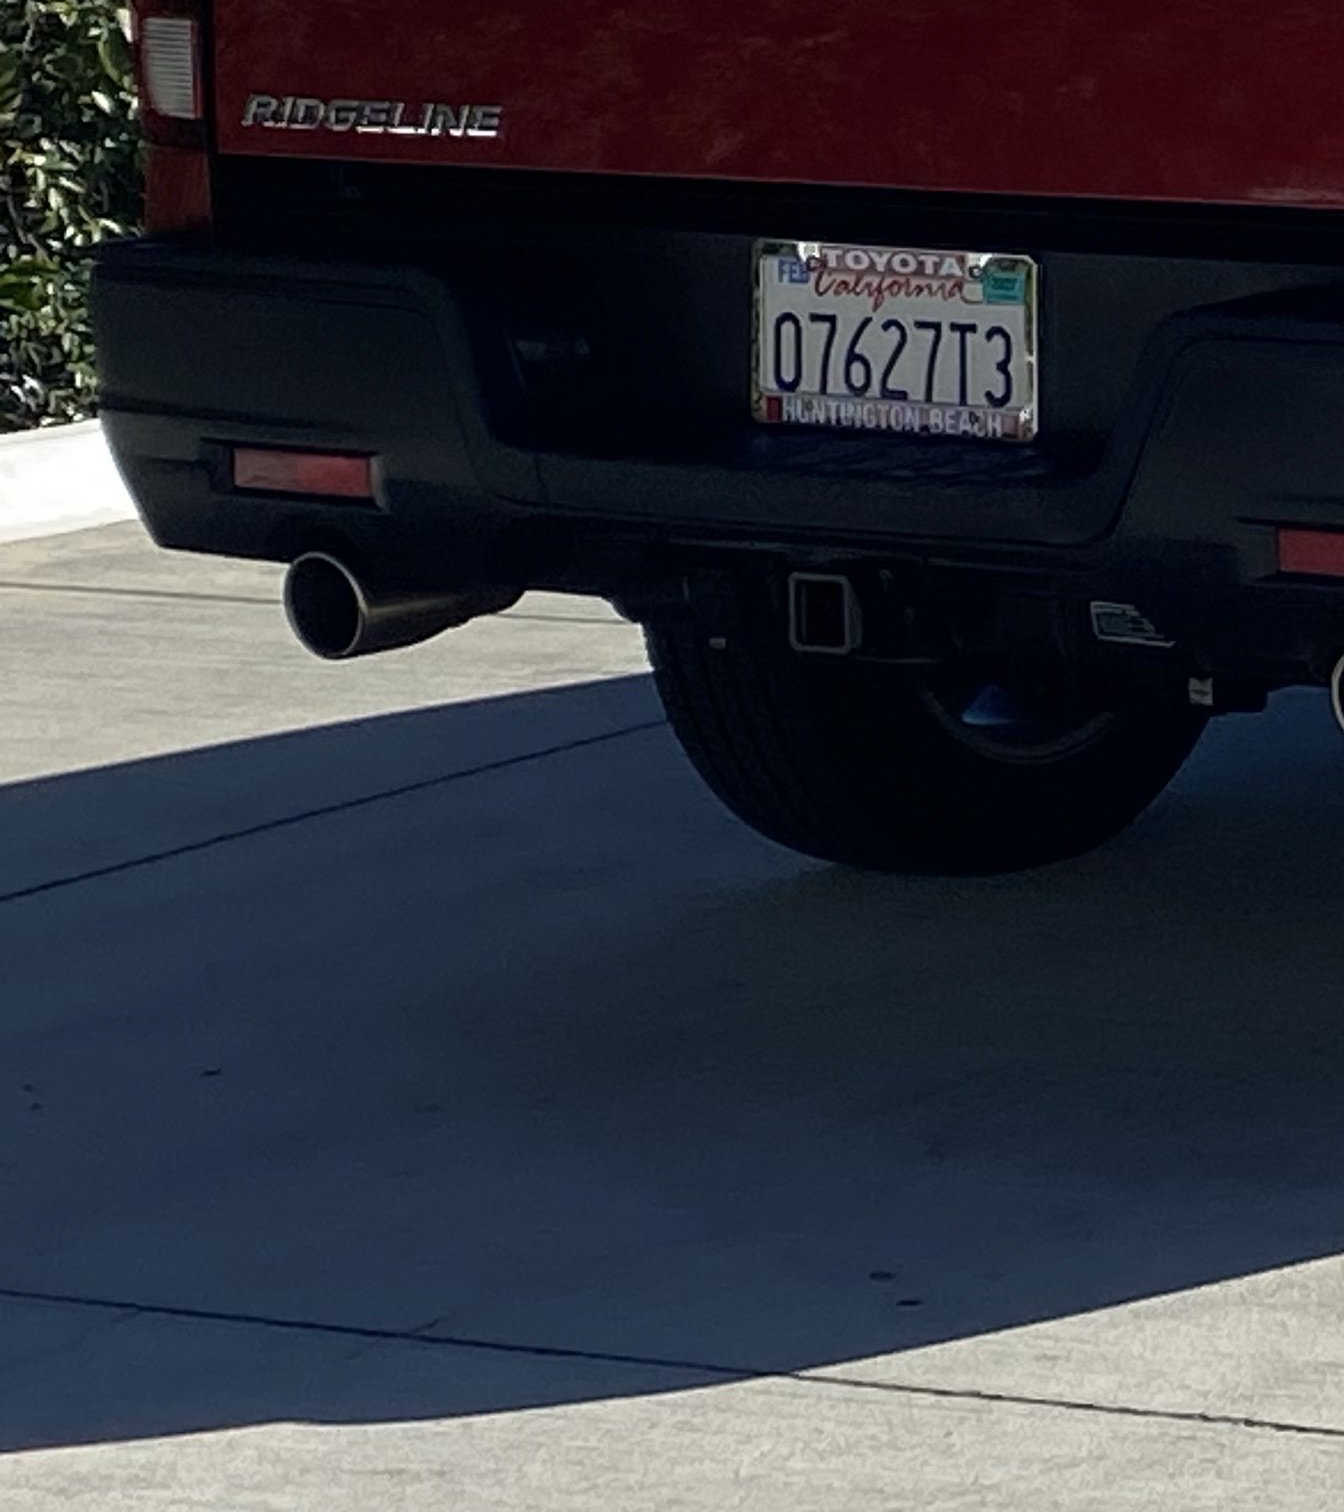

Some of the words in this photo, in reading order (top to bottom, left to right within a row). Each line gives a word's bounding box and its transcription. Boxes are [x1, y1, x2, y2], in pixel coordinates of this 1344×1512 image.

[241, 94, 504, 137] RIDGELINE
[821, 247, 963, 278] TOYOTA
[813, 268, 985, 312] California
[773, 311, 1013, 408] 07627T3
[782, 396, 919, 433] HUNTINGTON
[929, 407, 1003, 438] BEACH
